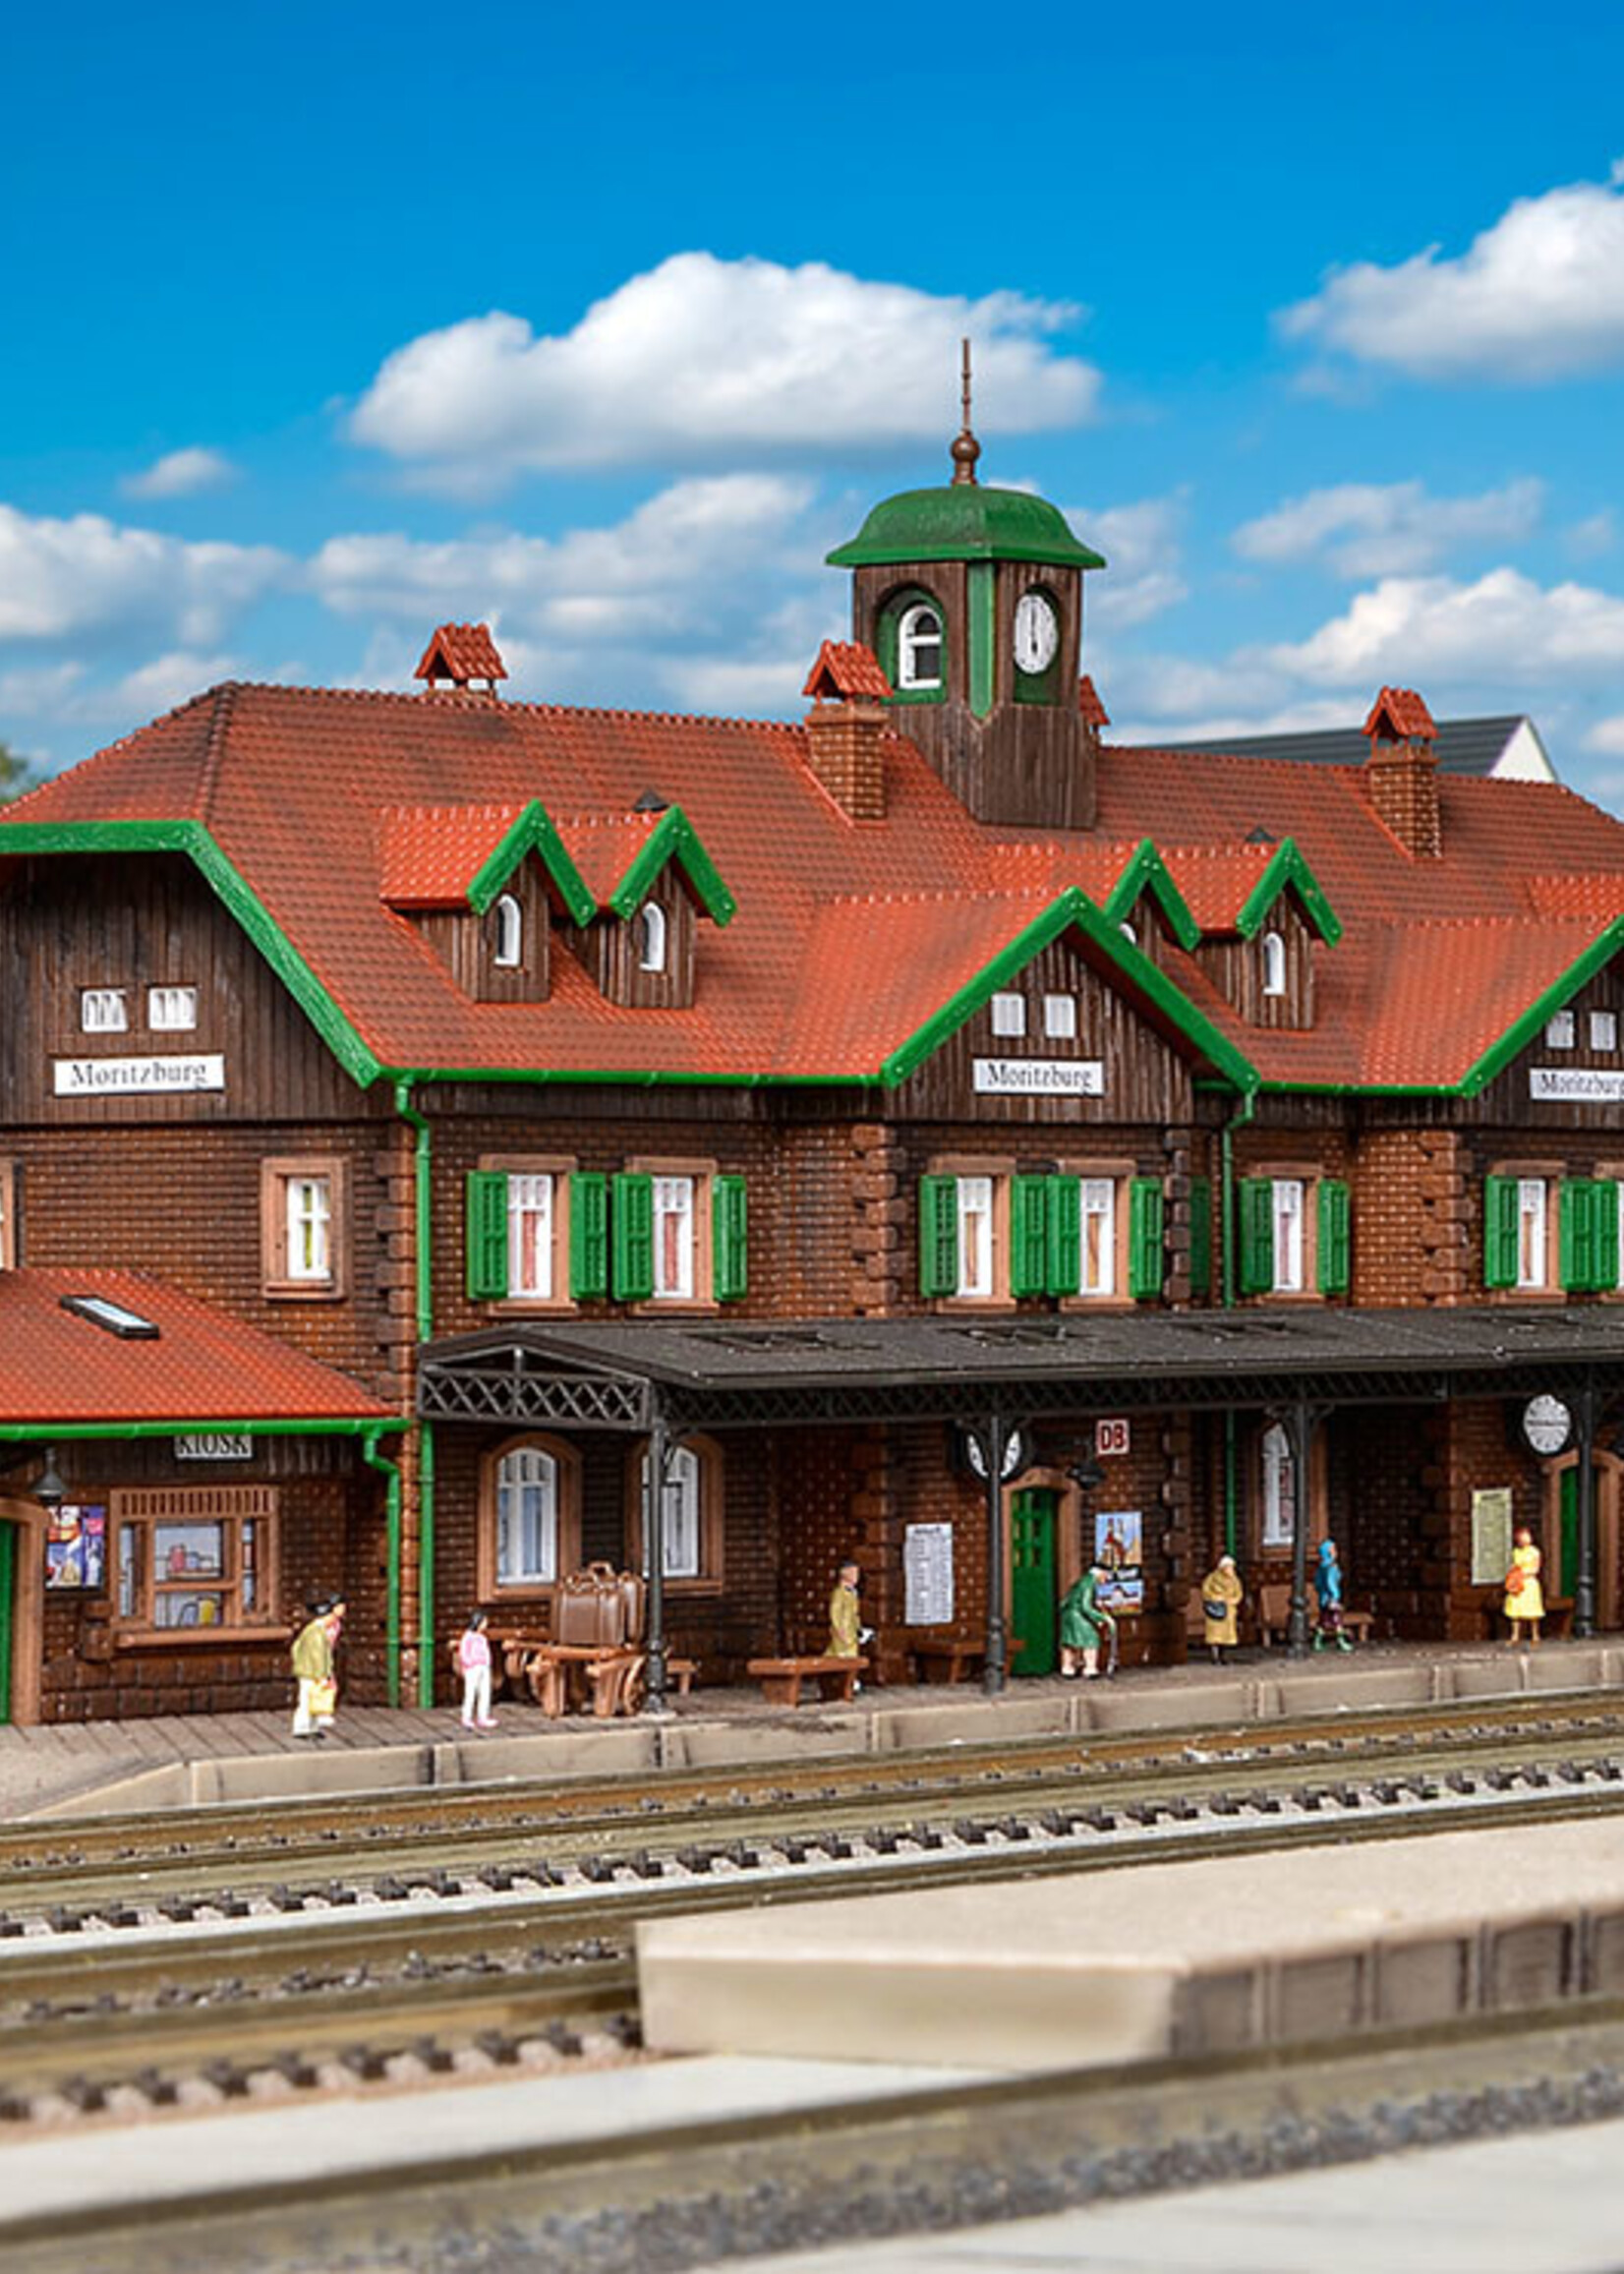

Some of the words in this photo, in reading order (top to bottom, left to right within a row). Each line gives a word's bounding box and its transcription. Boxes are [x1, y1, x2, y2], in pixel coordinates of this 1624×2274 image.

[71, 1062, 207, 1089] Moritzburg
[987, 1063, 1092, 1090] Moritzburg
[178, 1434, 249, 1455] KIOSK
[1100, 1424, 1126, 1450] DB
